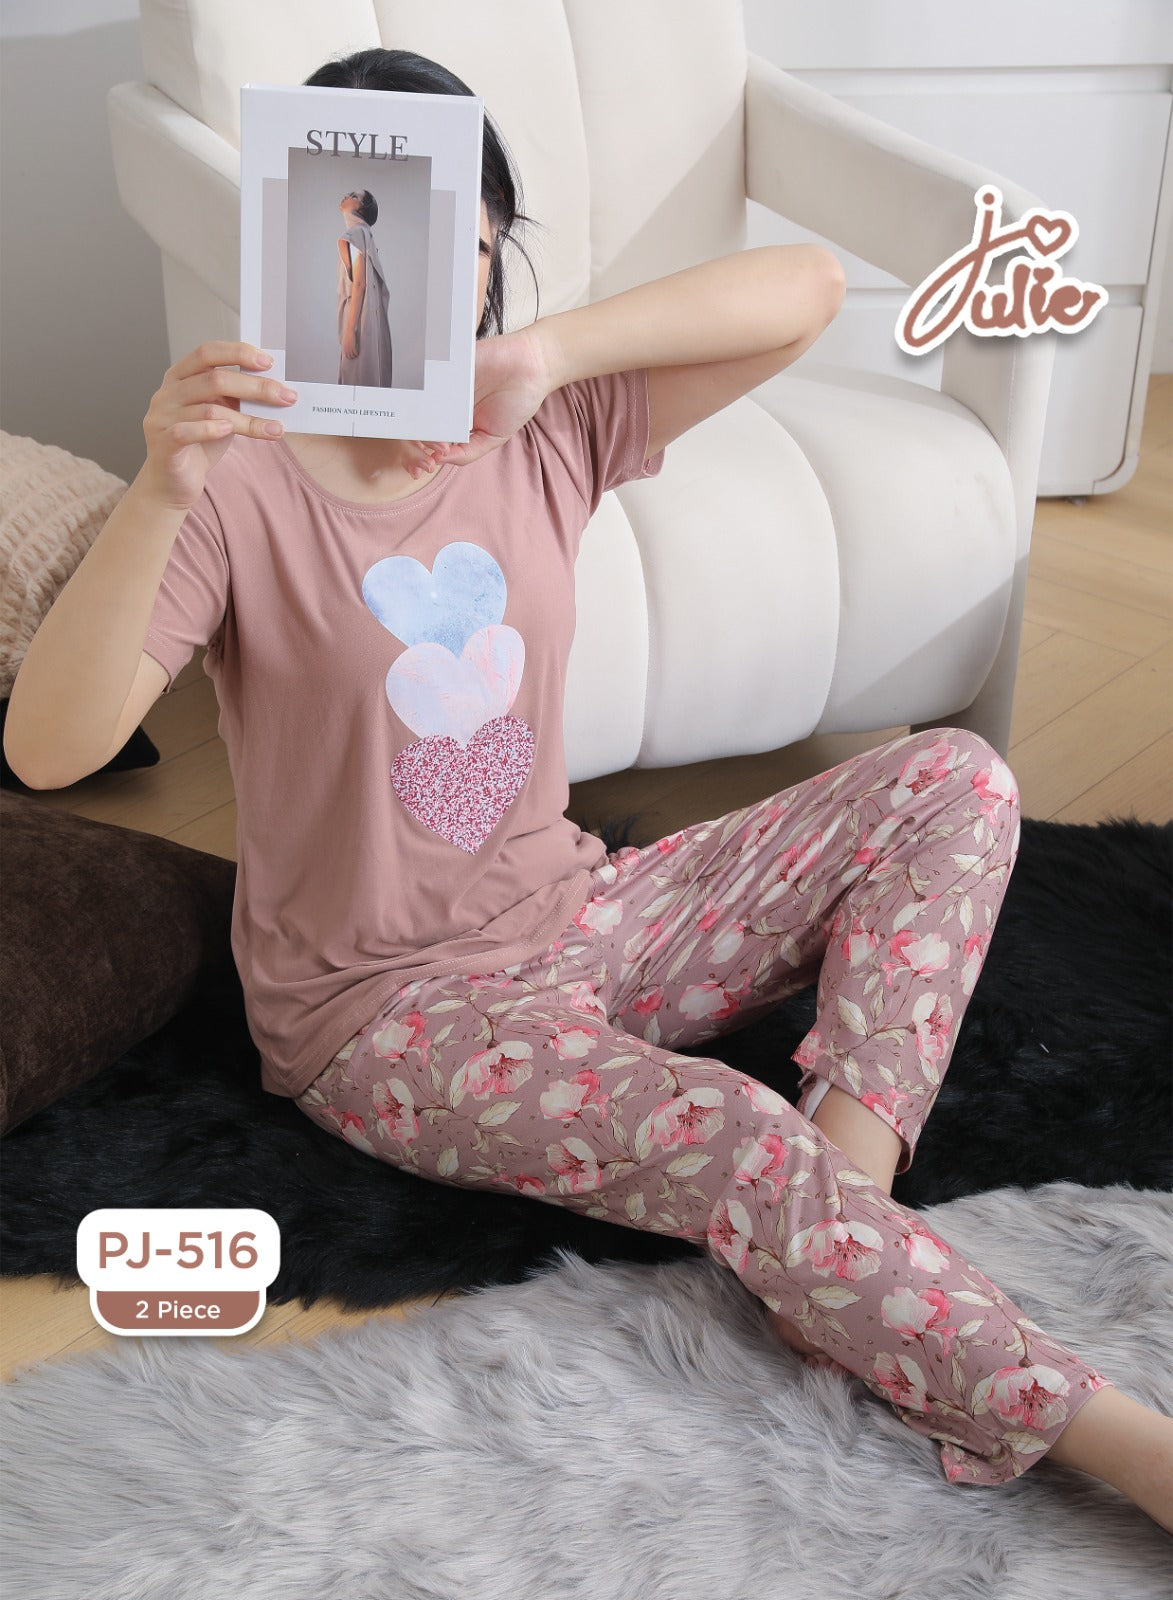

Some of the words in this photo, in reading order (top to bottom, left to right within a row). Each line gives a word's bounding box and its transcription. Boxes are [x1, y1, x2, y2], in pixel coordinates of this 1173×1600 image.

[306, 129, 408, 161] STYLE
[312, 406, 342, 414] FASHION
[343, 407, 358, 415] AND
[359, 409, 396, 417] LIFESTYLE
